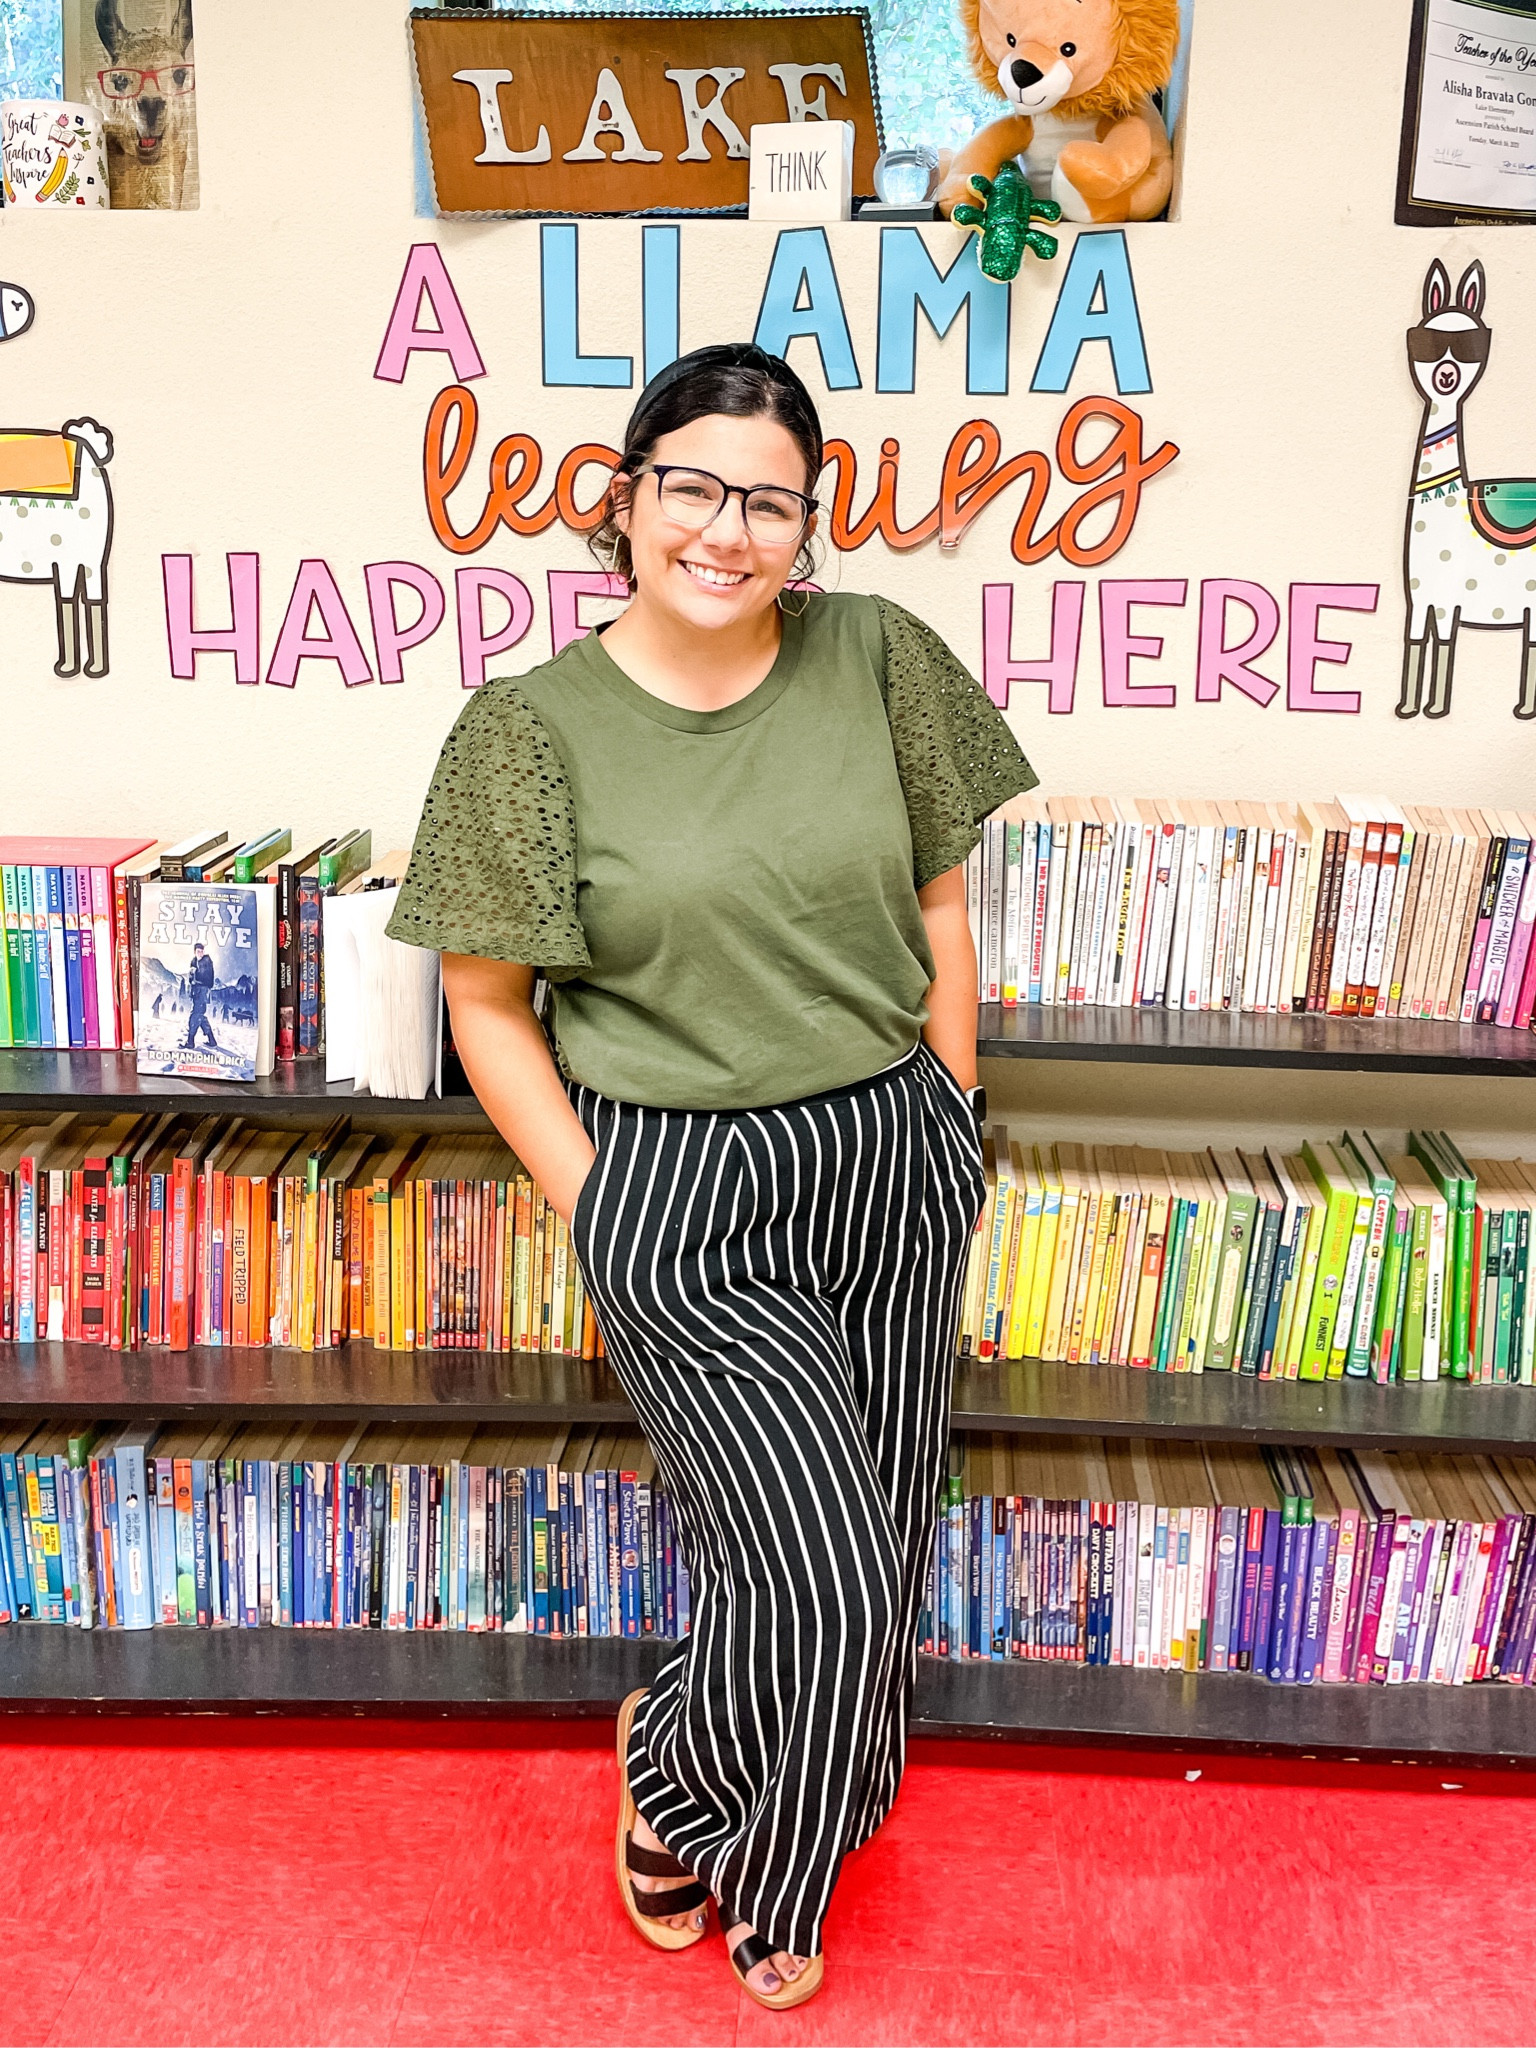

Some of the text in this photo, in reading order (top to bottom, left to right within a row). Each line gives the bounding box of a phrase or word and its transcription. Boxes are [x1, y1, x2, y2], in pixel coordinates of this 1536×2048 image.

[1455, 33, 1489, 58] Teacher
[1499, 49, 1513, 63] the
[1443, 79, 1473, 97] Alisha
[1476, 86, 1514, 103] Bravata
[453, 63, 854, 162] LAKE
[765, 150, 828, 193] THINK
[374, 243, 486, 384] A
[982, 577, 1380, 714] HERE
[20, 875, 28, 907] NAYLOR
[49, 873, 58, 907] NAYLOR
[66, 875, 74, 907] NAYLOR
[80, 875, 88, 907] NAYLOR
[1499, 876, 1520, 918] SNICKER
[159, 901, 245, 926] STAY
[1021, 872, 1033, 965] TOUCHING SPIRIT BEAR
[148, 922, 252, 949] ALIVE
[1032, 929, 1043, 976] PENGUINS
[1489, 930, 1508, 964] MAGIC
[149, 1051, 195, 1063] RODMAN
[152, 1176, 161, 1208] RASKIN
[38, 1212, 46, 1250] TITANIC
[352, 1208, 360, 1256] JUDY BLUME
[1082, 1199, 1098, 1276] LORD handful
[1373, 1199, 1387, 1240] KATFISH
[1419, 1210, 1428, 1240] CREECH
[21, 1188, 32, 1318] TELL ME EVERYTHING
[90, 1225, 98, 1268] ELEPHANTS
[173, 1186, 186, 1301] THE TRADING GAME
[984, 1181, 1009, 1338] The Old Farmer's Almanac for Kids
[235, 1229, 246, 1304] FIELD TRIPPED
[1410, 1267, 1424, 1315] Ruby Holler
[1430, 1273, 1440, 1340] LUNCH MONEY
[1315, 1317, 1329, 1352] FUNNIEST
[30, 1483, 38, 1512] LORD
[535, 1531, 546, 1567] LIBERTY
[1317, 1524, 1327, 1551] SEWELL
[1090, 1528, 1100, 1599] DAVY CROCKETT
[1104, 1531, 1114, 1595] BUFFALO BILL
[1245, 1563, 1257, 1589] HOLES
[1263, 1565, 1274, 1591] HOLES
[1404, 1548, 1417, 1582] QUINN
[981, 1542, 990, 1633] THE SUMMER OF RILEY
[1138, 1580, 1149, 1628] STRAYS LIKE US
[1307, 1565, 1322, 1640] BLACK BEAUTY
[995, 1601, 1003, 1617] Dog
